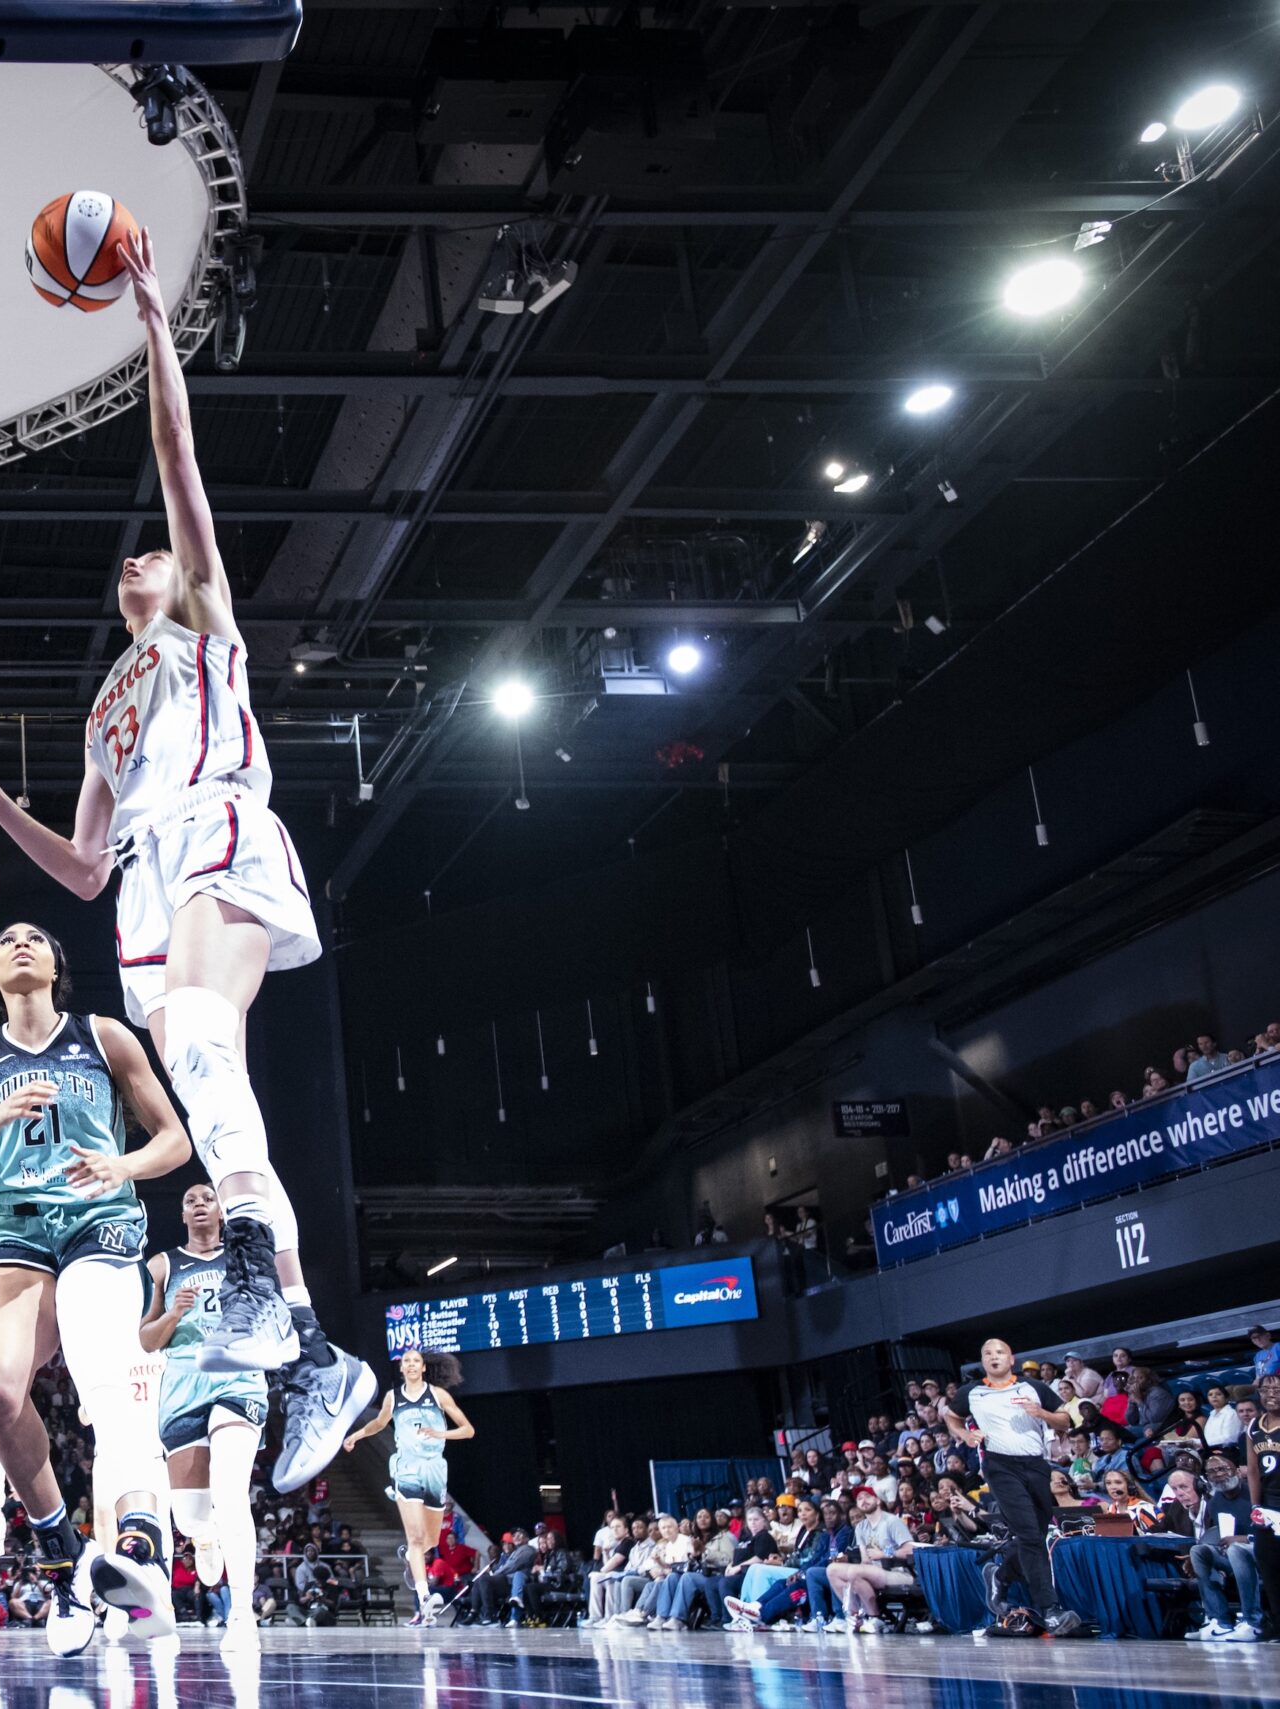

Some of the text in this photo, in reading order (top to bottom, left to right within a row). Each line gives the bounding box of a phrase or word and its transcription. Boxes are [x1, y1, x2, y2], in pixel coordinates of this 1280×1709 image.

[105, 704, 140, 776] 33
[23, 1103, 63, 1148] 21
[978, 1172, 1046, 1214] Making
[1047, 1171, 1060, 1190] a
[1062, 1131, 1164, 1182] difference
[1166, 1106, 1244, 1148] where
[884, 1209, 936, 1246] CareFirst
[1114, 1210, 1139, 1225] SECTION
[1116, 1222, 1150, 1269] 112
[202, 1288, 223, 1313] 2
[440, 1298, 469, 1310] PLAYER
[482, 1294, 497, 1304] PTS
[508, 1288, 529, 1301] ASST
[542, 1285, 560, 1296] REB
[571, 1281, 587, 1292] STL
[602, 1277, 619, 1289] BLK
[635, 1273, 651, 1284] FLS
[430, 1309, 458, 1321] Sutton
[488, 1303, 495, 1313] 7
[488, 1320, 499, 1331] 10
[490, 1337, 501, 1348] 12
[553, 1330, 560, 1341] 7
[131, 1381, 148, 1401] 21
[1262, 1455, 1277, 1474] 9
